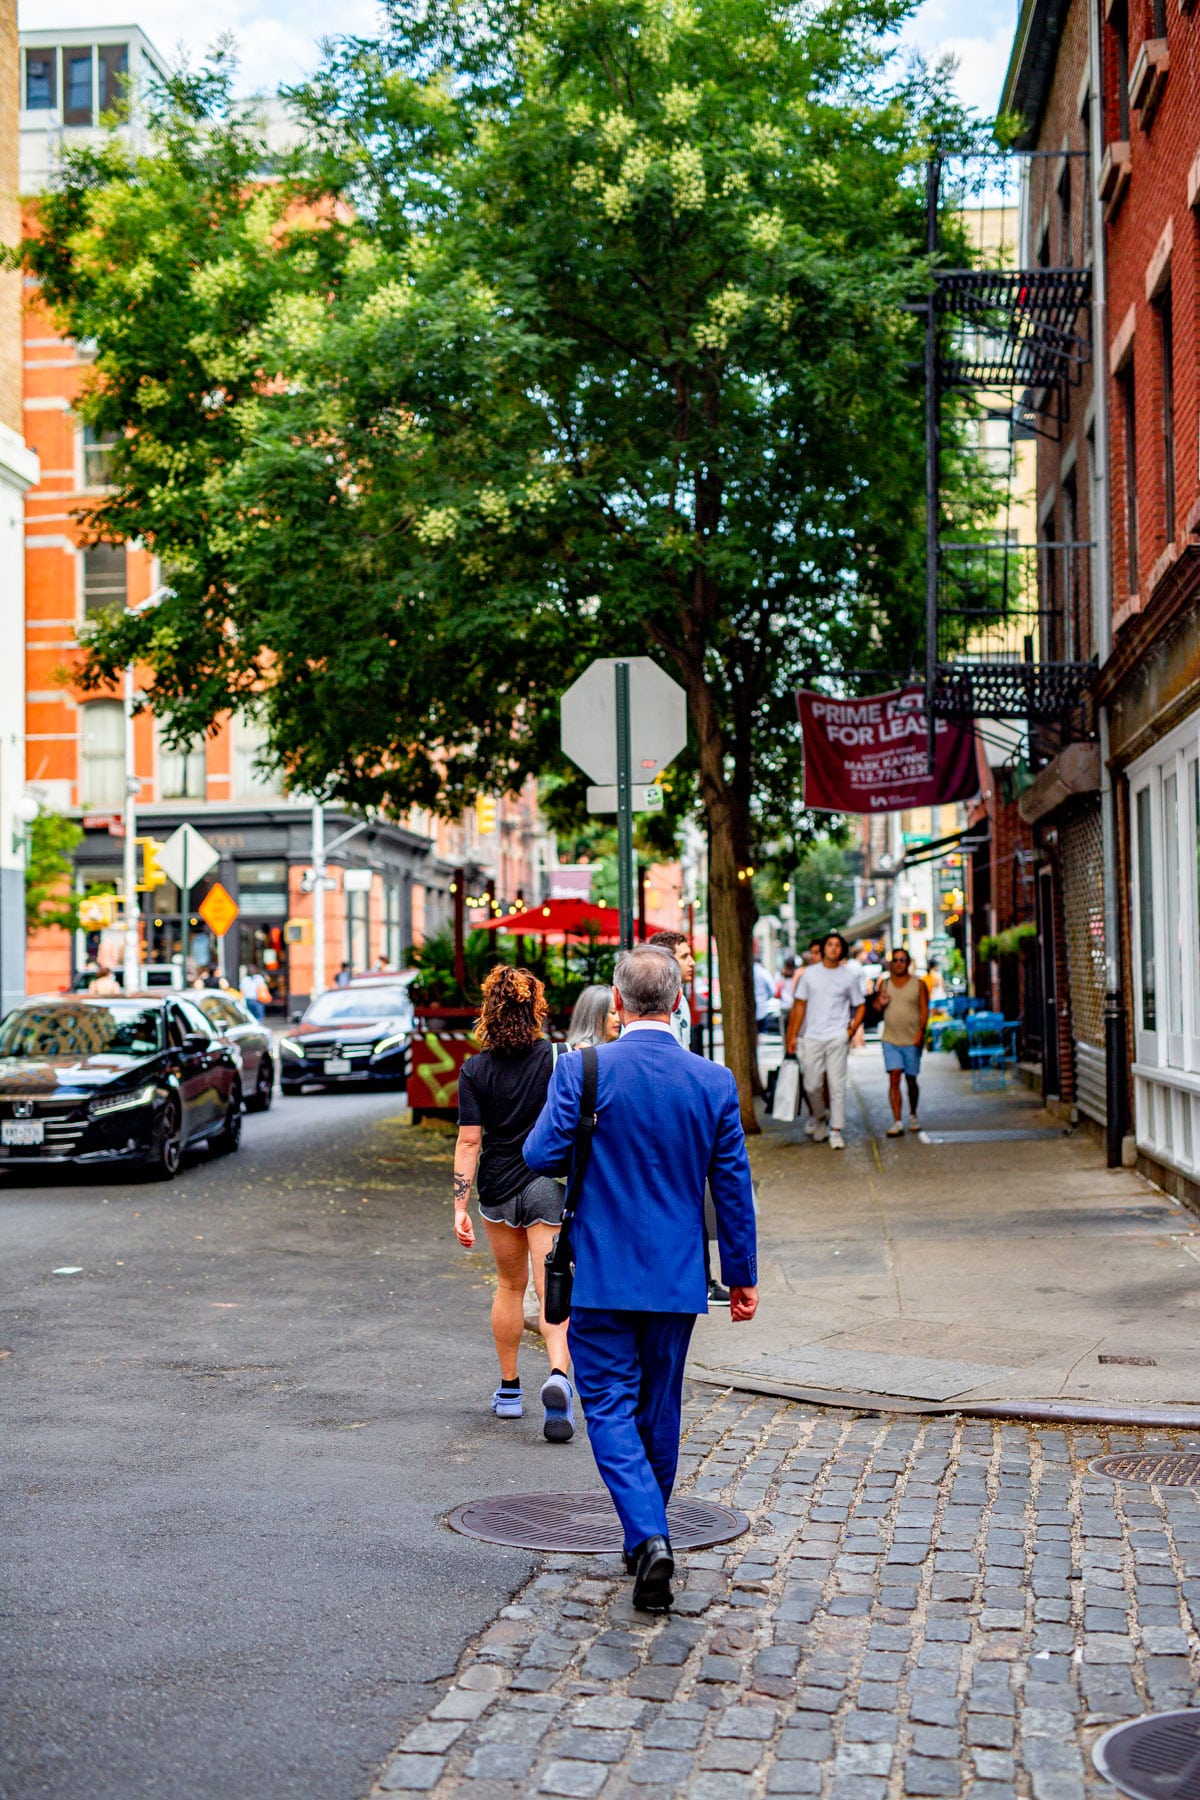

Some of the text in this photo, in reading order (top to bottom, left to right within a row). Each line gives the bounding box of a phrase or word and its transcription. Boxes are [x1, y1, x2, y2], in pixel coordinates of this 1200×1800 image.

[812, 701, 882, 725] PRIME
[826, 715, 948, 746] FOR LEASE
